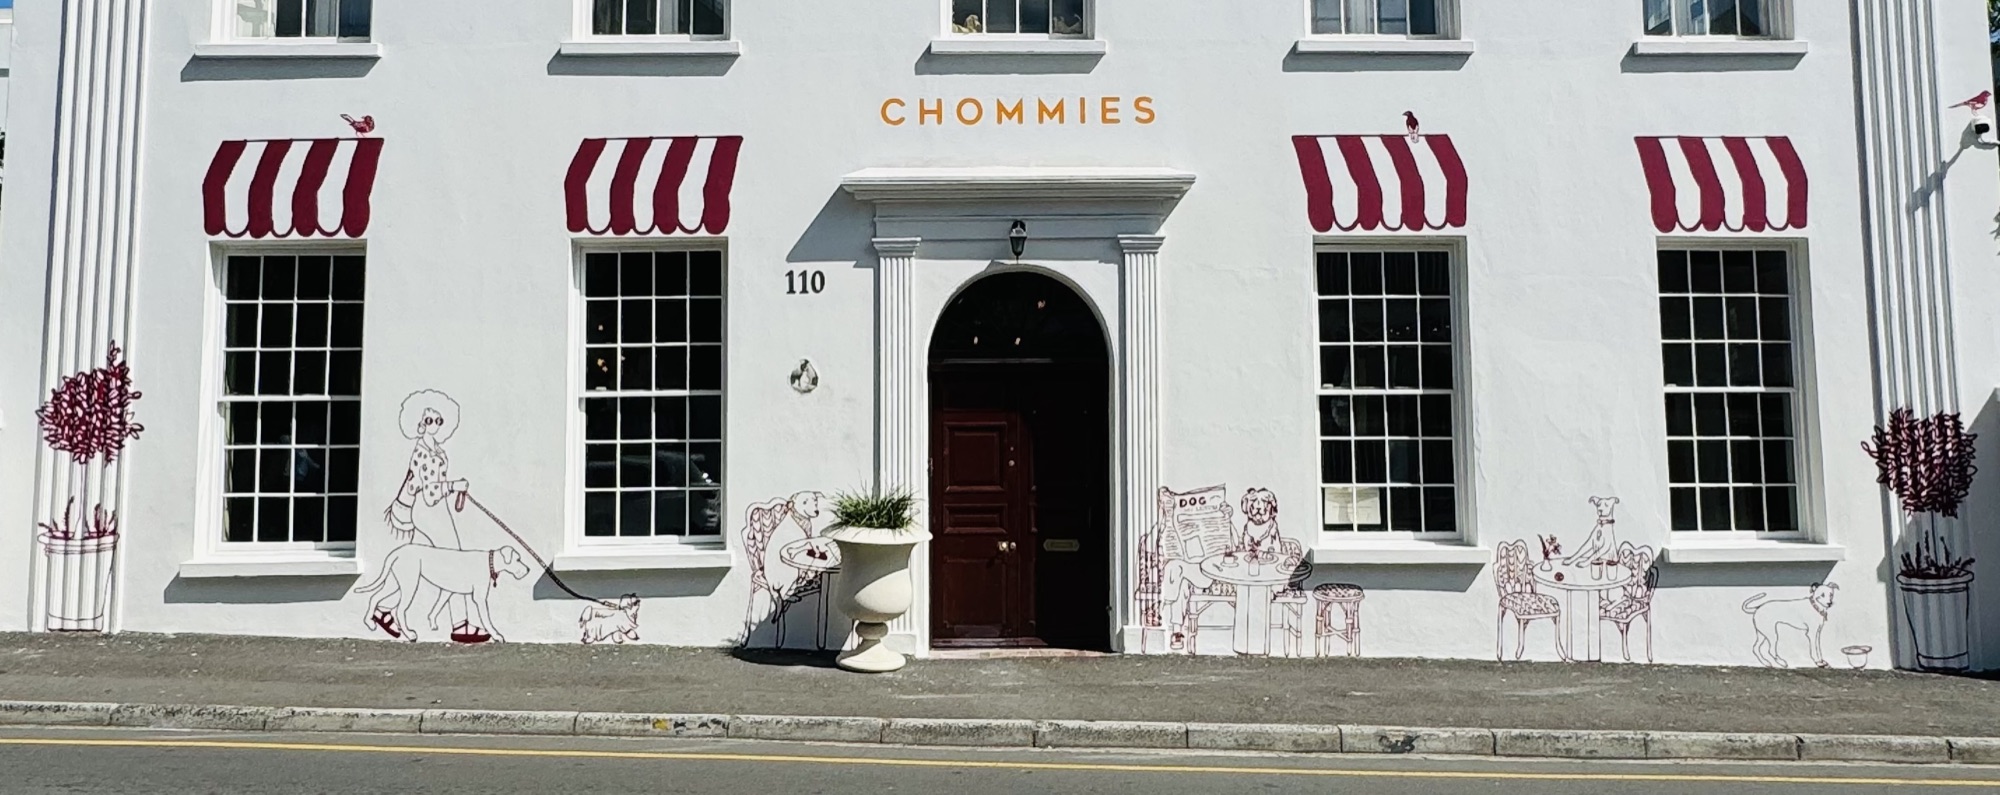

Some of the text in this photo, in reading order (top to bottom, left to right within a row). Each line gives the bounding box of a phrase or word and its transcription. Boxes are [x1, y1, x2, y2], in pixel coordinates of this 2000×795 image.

[880, 96, 1156, 126] CHOMMIES
[785, 269, 826, 295] 110
[1179, 496, 1207, 508] DOG
